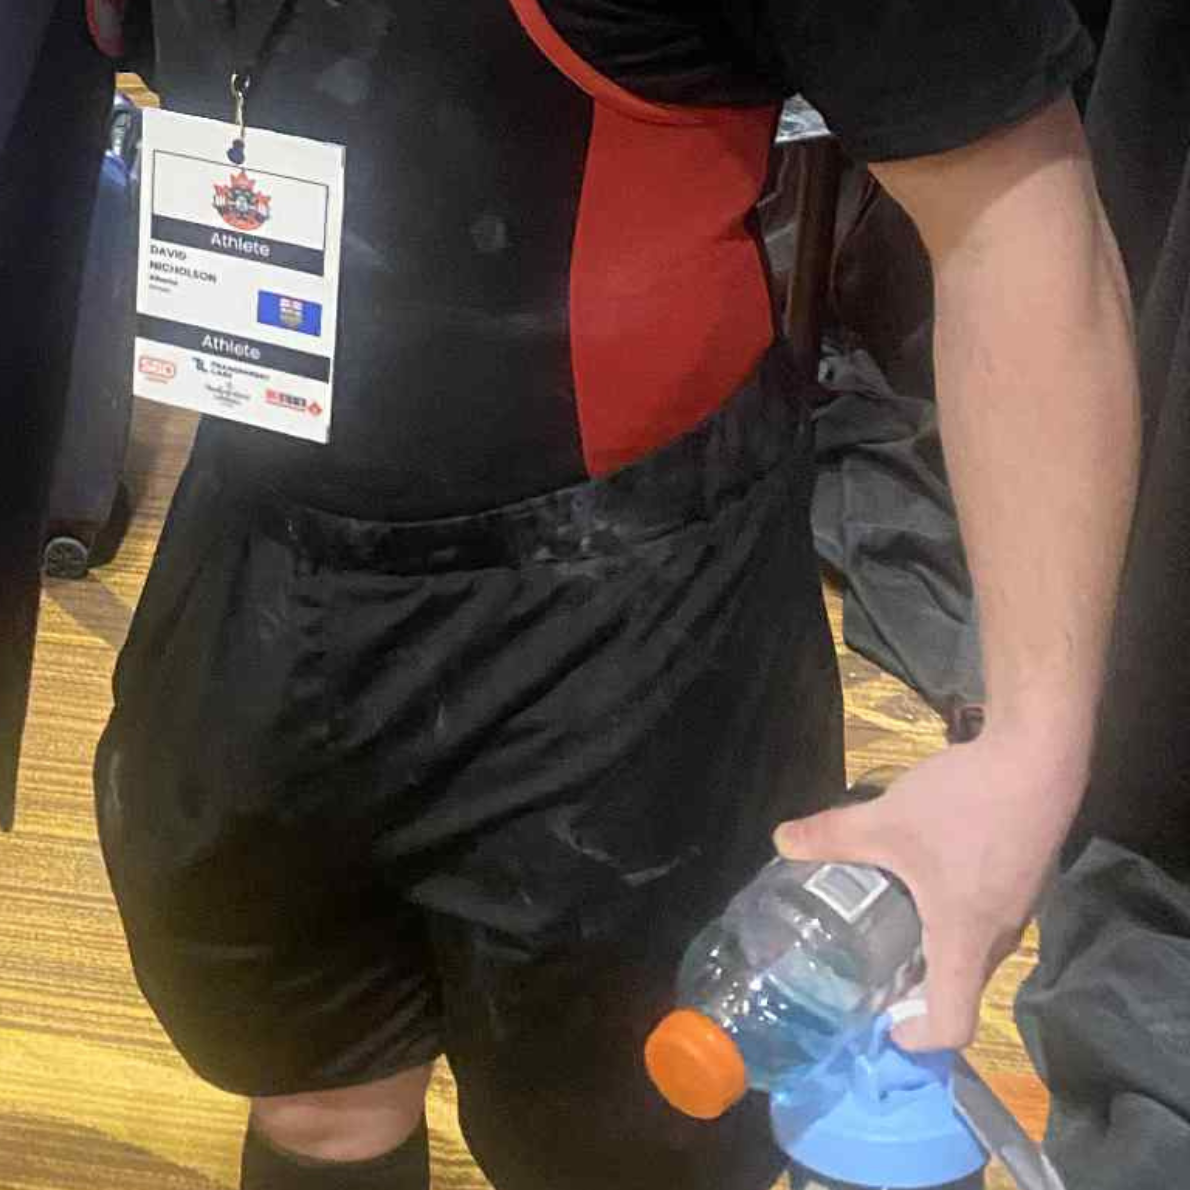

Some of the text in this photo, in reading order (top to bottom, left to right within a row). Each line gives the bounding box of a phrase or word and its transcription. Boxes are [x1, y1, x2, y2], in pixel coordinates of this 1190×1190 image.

[150, 244, 187, 261] DAVID
[210, 231, 271, 258] Athlete
[150, 259, 217, 285] NICHOLSON
[201, 333, 261, 360] Athlete
